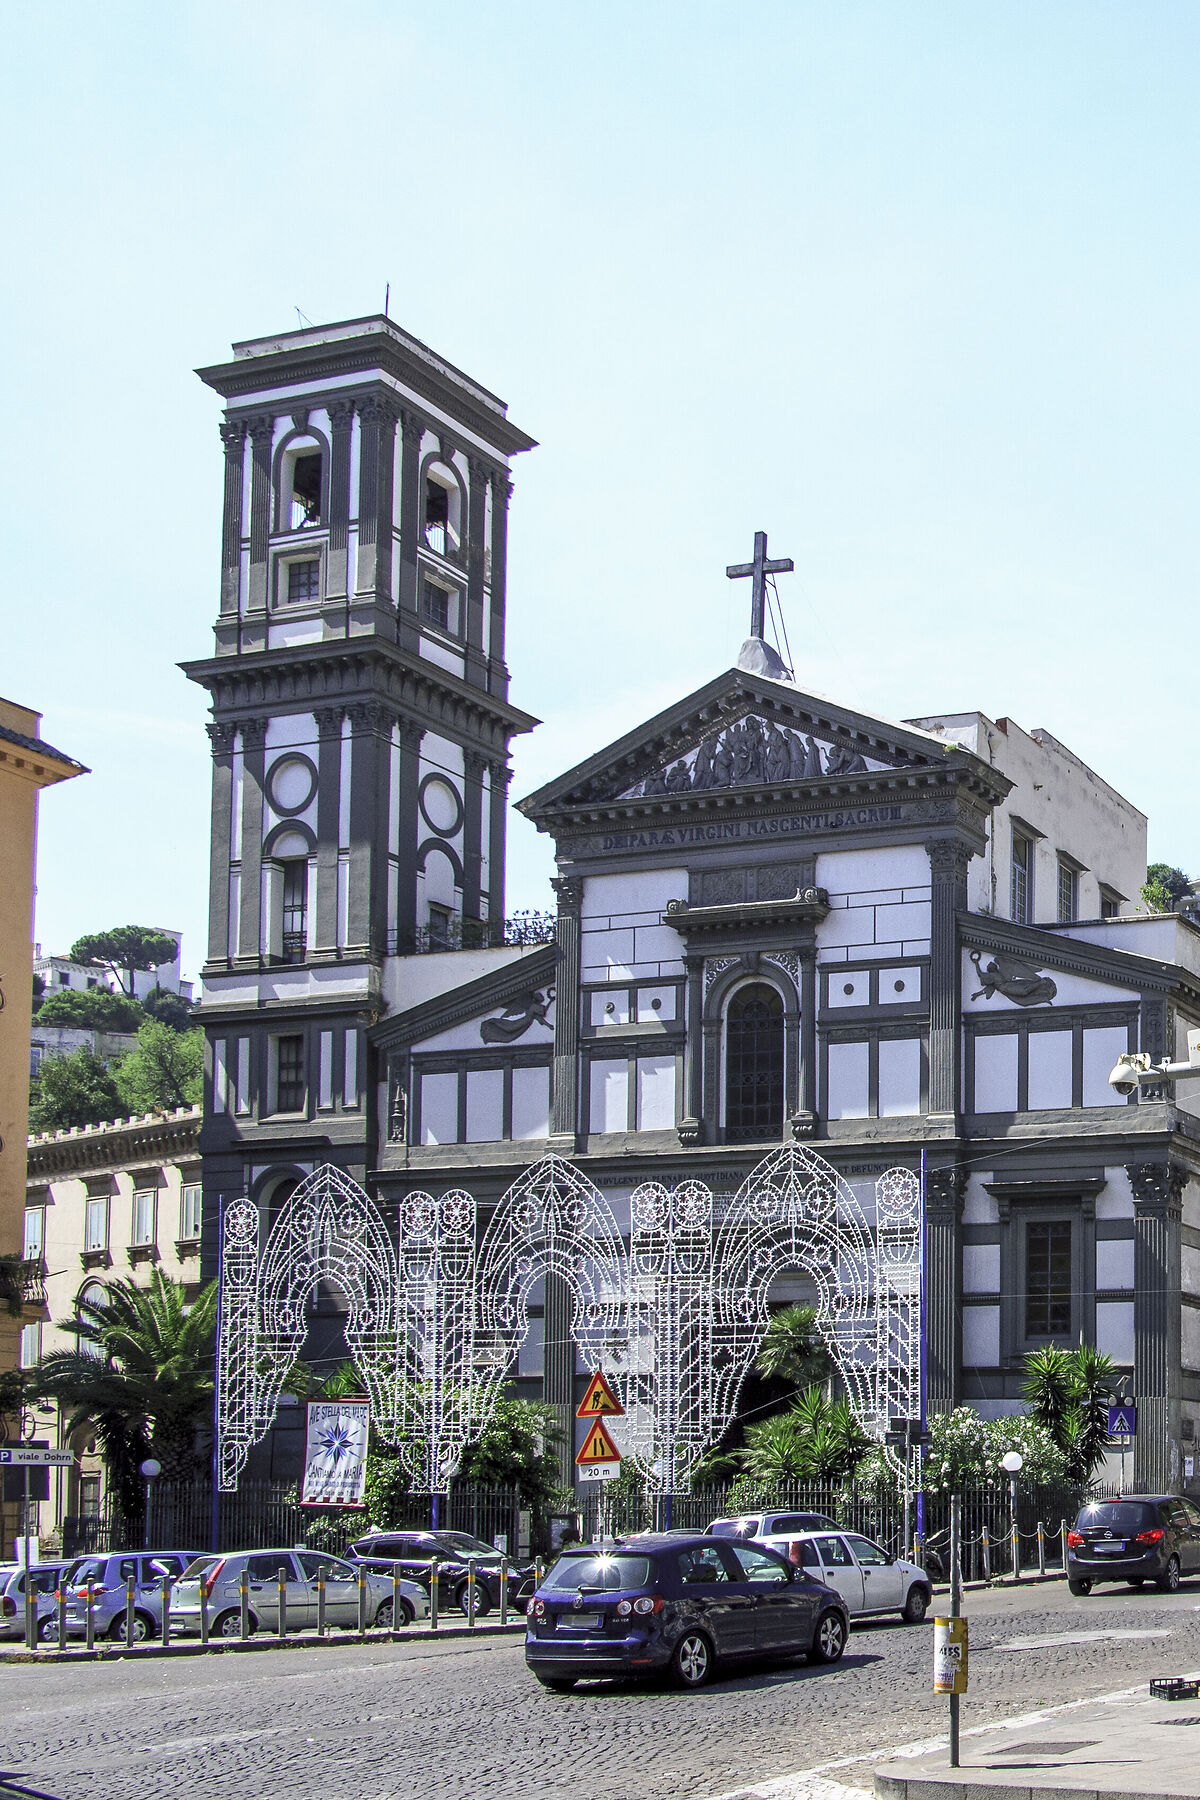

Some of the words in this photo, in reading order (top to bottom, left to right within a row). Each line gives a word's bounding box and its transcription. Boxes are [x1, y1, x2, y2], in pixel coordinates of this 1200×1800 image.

[678, 823, 741, 842] VIRGINI
[747, 813, 829, 836] NASCENTI
[835, 805, 902, 827] SACRUM
[309, 1405, 320, 1425] AVE
[322, 1405, 340, 1419] STELLA
[0, 1452, 9, 1461] P
[18, 1452, 40, 1460] viale
[44, 1453, 71, 1461] Dohrn
[343, 1464, 362, 1479] MARIA
[588, 1468, 600, 1477] 20
